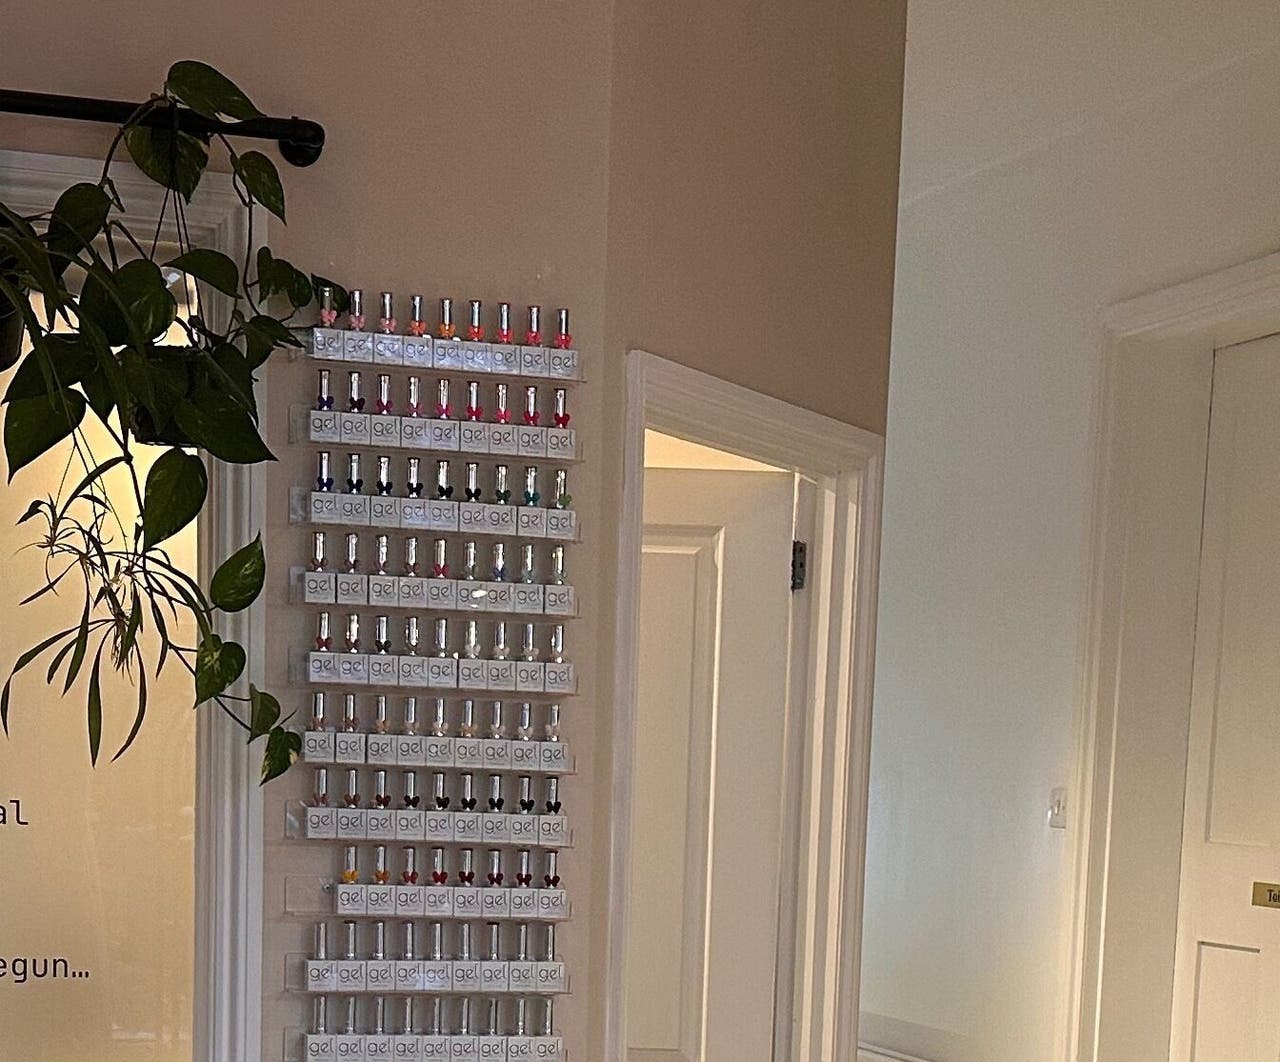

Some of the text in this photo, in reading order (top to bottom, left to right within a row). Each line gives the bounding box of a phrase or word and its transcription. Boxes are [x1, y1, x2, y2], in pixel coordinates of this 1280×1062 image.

[436, 340, 460, 359] gel
[466, 344, 489, 362] gel
[494, 345, 518, 366] gel
[523, 349, 549, 367] gel
[552, 351, 576, 371] gel
[313, 414, 337, 433] gel
[343, 416, 367, 435] gel
[374, 418, 398, 437] gel
[404, 421, 428, 438] gel
[433, 422, 457, 440] gel
[463, 425, 486, 442] gel
[492, 426, 515, 444] gel
[521, 429, 545, 446] gel
[550, 431, 574, 449] gel
[313, 496, 337, 514] gel
[343, 498, 367, 515] gel
[373, 499, 398, 517] gel
[403, 501, 426, 519] gel
[432, 503, 455, 520] gel
[462, 506, 486, 523] gel
[490, 506, 514, 525] gel
[521, 511, 544, 527] gel
[549, 512, 573, 530] gel
[308, 575, 332, 593] gel
[340, 577, 364, 594] gel
[372, 579, 396, 596] gel
[402, 580, 424, 597] gel
[430, 581, 454, 598] gel
[489, 584, 511, 601] gel
[517, 586, 541, 602] gel
[548, 587, 571, 606] gel
[312, 655, 338, 673] gel
[341, 657, 366, 674] gel
[372, 658, 396, 676] gel
[402, 660, 426, 678] gel
[431, 660, 455, 677] gel
[462, 664, 485, 680] gel
[490, 663, 513, 681] gel
[520, 666, 543, 682] gel
[548, 667, 571, 683] gel
[307, 734, 332, 753] gel
[339, 735, 363, 754] gel
[370, 738, 394, 755] gel
[400, 739, 424, 756] gel
[429, 739, 452, 758] gel
[456, 741, 482, 759] gel
[485, 742, 510, 760] gel
[514, 744, 539, 761] gel
[542, 744, 567, 762] gel
[309, 811, 335, 829] gel
[340, 812, 365, 829] gel
[370, 814, 393, 830] gel
[399, 814, 422, 830] gel
[428, 815, 452, 831] gel
[456, 815, 480, 832] gel
[485, 816, 508, 833] gel
[513, 818, 536, 834] gel
[541, 819, 564, 836] gel
[340, 887, 364, 905] gel
[370, 887, 393, 906] gel
[398, 888, 421, 906] gel
[427, 889, 450, 907] gel
[456, 890, 479, 908] gel
[485, 891, 507, 908] gel
[513, 891, 535, 908] gel
[541, 892, 564, 909] gel
[310, 964, 335, 981] gel
[340, 964, 364, 982] gel
[370, 964, 392, 982] gel
[398, 964, 420, 981] gel
[426, 965, 449, 982] gel
[455, 965, 477, 982] gel
[483, 965, 506, 982] gel
[511, 966, 534, 981] gel
[539, 966, 561, 981] gel
[309, 1037, 334, 1056] gel
[339, 1038, 363, 1056] gel
[368, 1038, 391, 1056] gel
[396, 1038, 419, 1056] gel
[424, 1039, 448, 1056] gel
[453, 1039, 477, 1056] gel
[482, 1040, 505, 1057] gel
[510, 1040, 533, 1057] gel
[537, 1040, 560, 1057] gel
